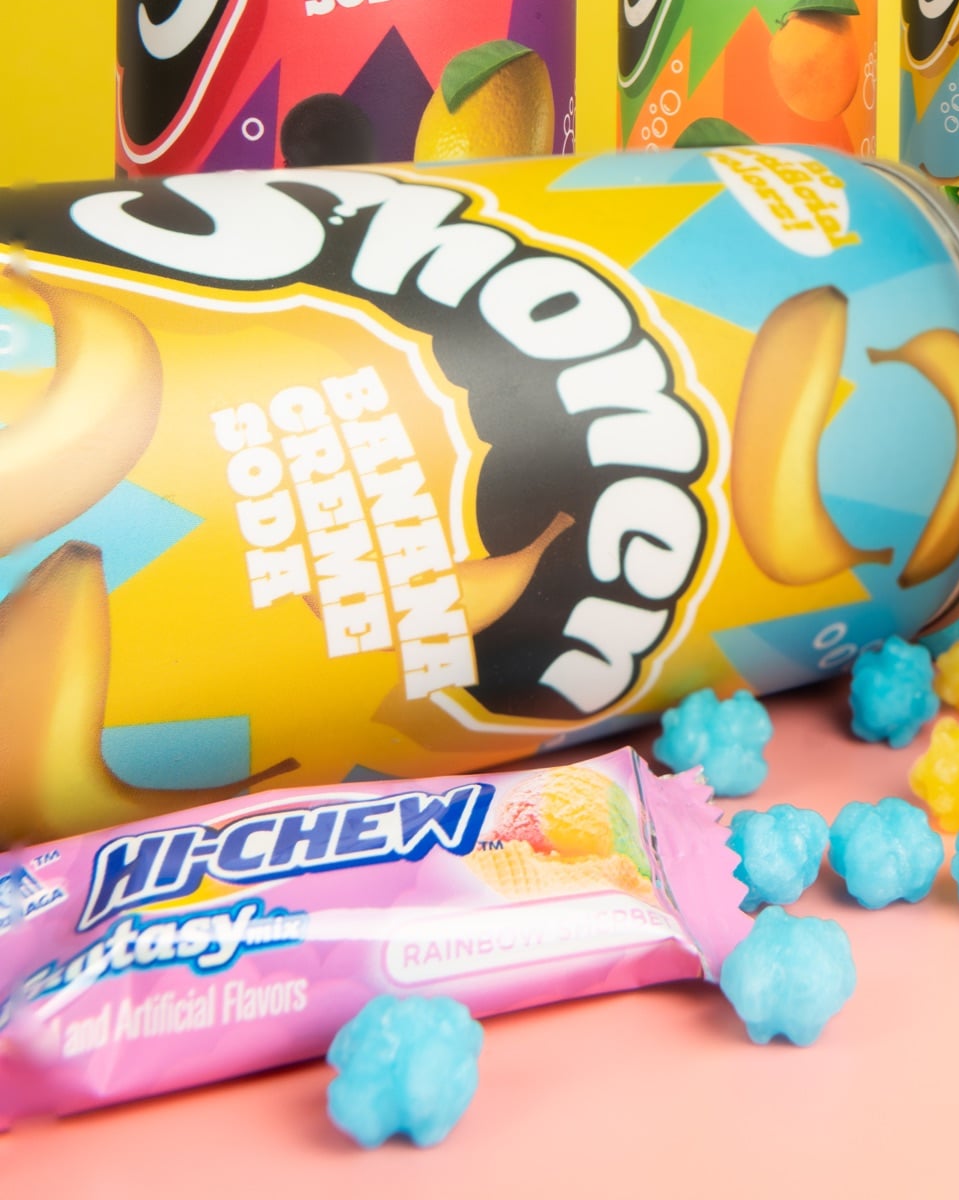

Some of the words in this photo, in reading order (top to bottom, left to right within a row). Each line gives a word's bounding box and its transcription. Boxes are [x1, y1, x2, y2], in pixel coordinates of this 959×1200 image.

[800, 159, 847, 190] no
[210, 402, 311, 610] SODA
[269, 385, 393, 658] CREME
[321, 365, 479, 701] BANANA
[81, 782, 495, 931] HI-CHEW
[480, 841, 504, 852] TM
[113, 985, 214, 1042] Artificial
[221, 978, 309, 1026] Flavors
